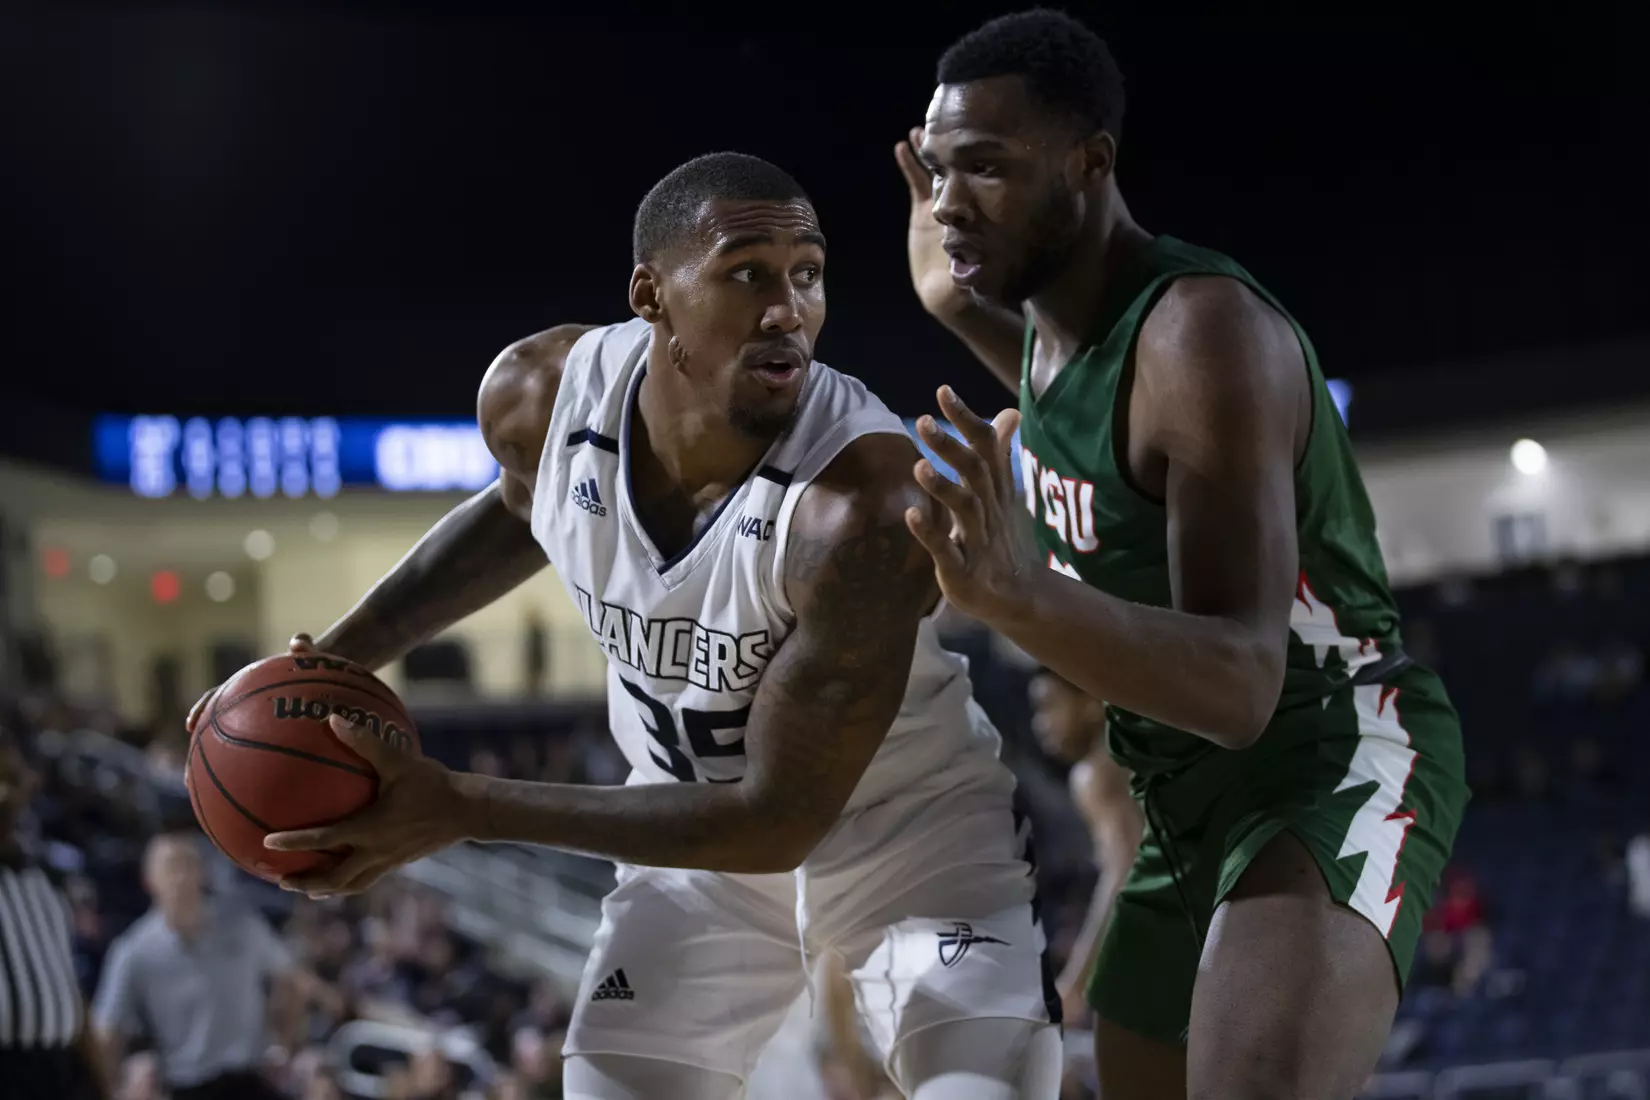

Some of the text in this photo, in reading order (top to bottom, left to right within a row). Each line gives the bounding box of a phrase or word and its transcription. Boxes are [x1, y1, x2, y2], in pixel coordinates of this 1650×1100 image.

[738, 515, 775, 541] WAC
[574, 583, 771, 693] LANCERS
[618, 672, 752, 784] 35
